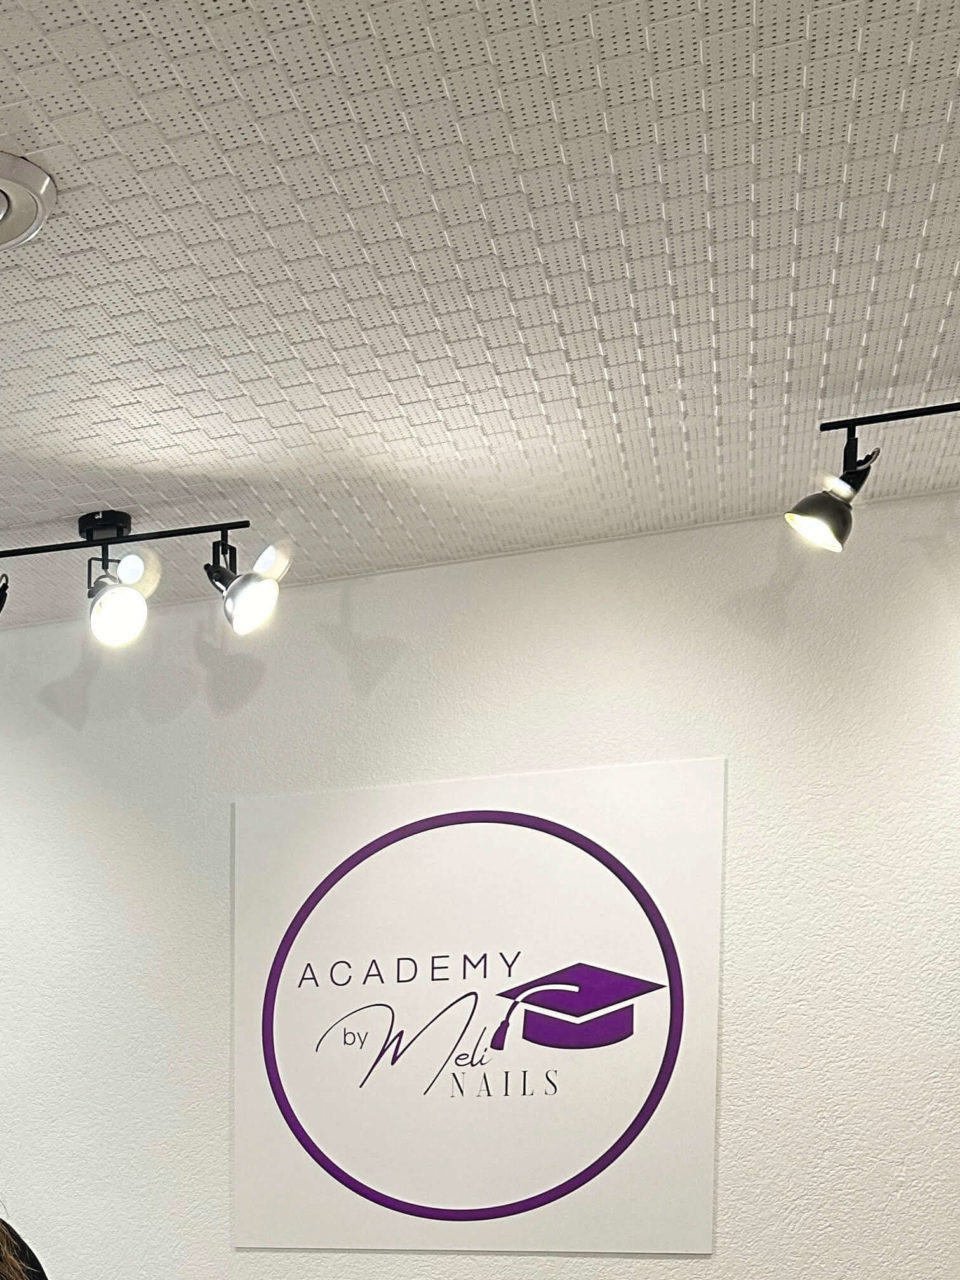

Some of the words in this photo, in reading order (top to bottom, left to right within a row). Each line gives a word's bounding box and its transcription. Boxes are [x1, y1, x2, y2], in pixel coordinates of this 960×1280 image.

[298, 951, 521, 988] ACADEMY
[316, 991, 491, 1095] Meli
[343, 1027, 368, 1050] by
[450, 1070, 559, 1098] NAILS
